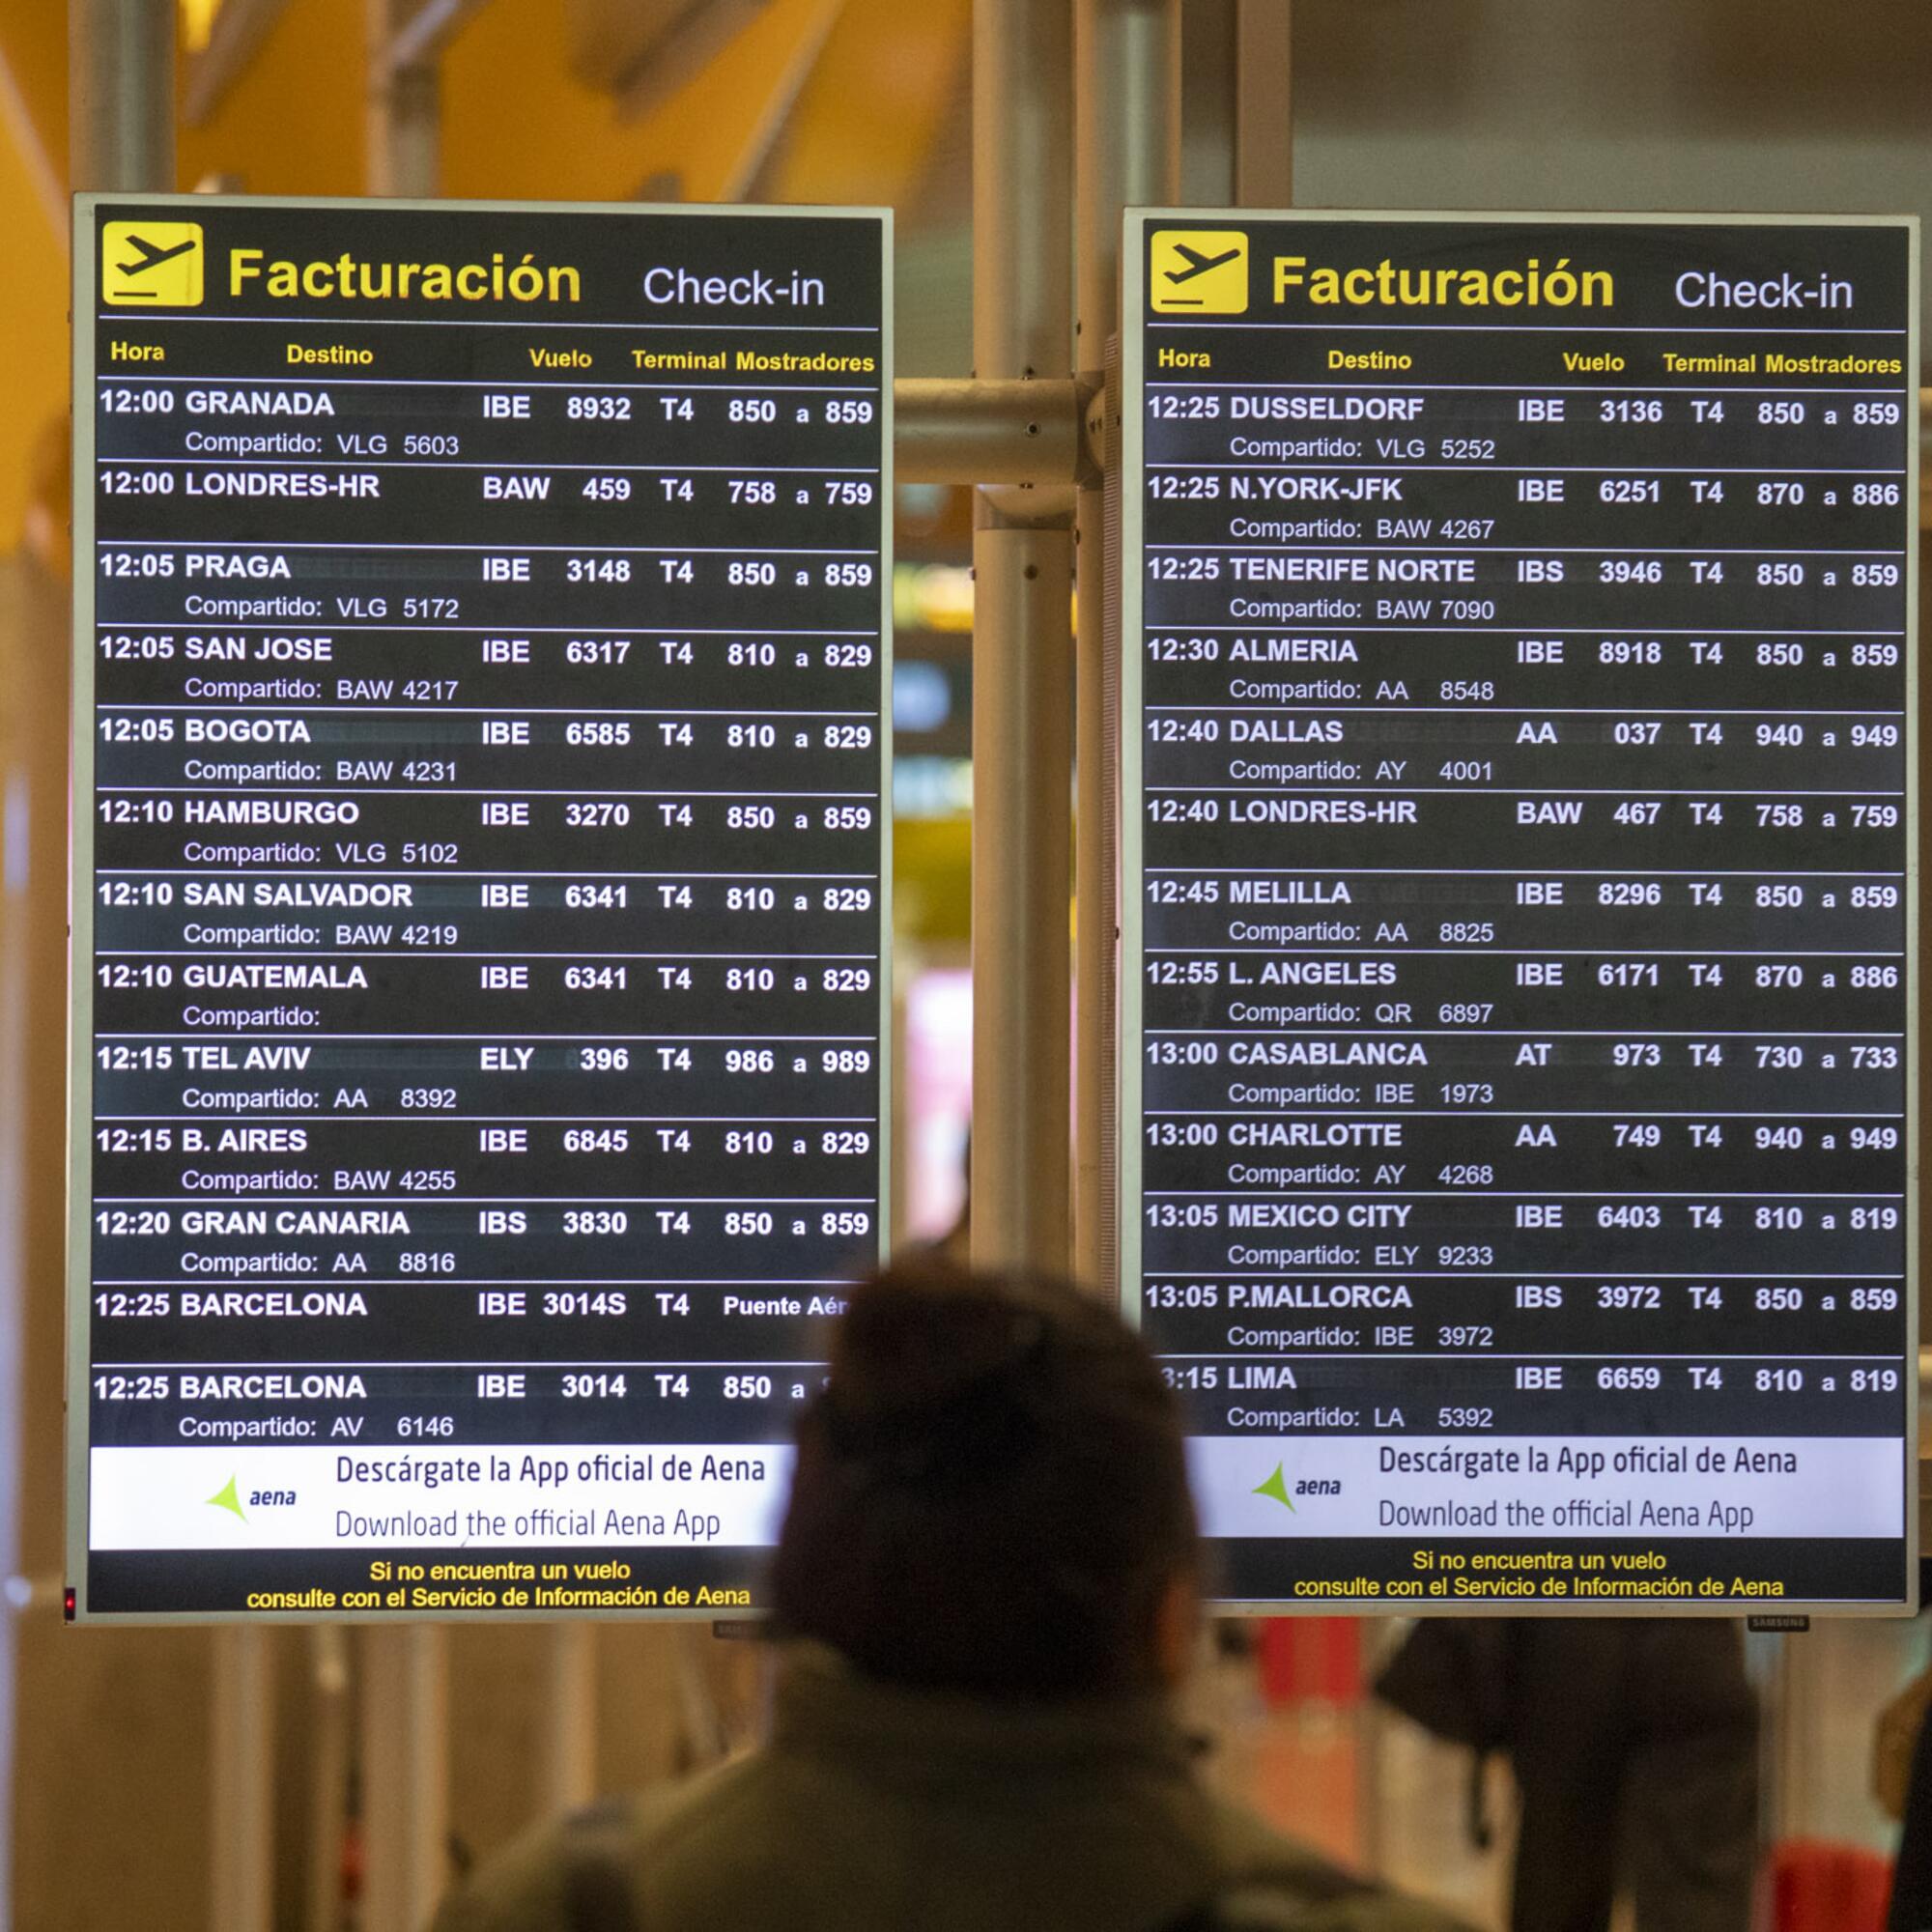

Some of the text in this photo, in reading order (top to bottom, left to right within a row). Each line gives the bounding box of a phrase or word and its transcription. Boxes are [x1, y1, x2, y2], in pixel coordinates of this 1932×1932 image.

[231, 249, 823, 305] Facturación Check-in
[1274, 257, 1852, 308] Facturación Check-in
[111, 341, 874, 372] Hora Destino Vuelo Terminal Mostradores
[1159, 349, 1901, 373] Hora Destino Vuelo Terminal Mostradores
[1148, 395, 1900, 425] 12:25 DUSSELDORF IBE 3136 T4 850 a 859
[100, 471, 872, 505] 12:00 LONDRES-HR BAW 459 T4 758 a 759
[1230, 598, 1494, 622] Compartido: BAW 7090
[99, 718, 871, 749] 12:05 BOGOTA IBE 6585 T4 810 a 829
[1148, 719, 1898, 747] 12:40 DALLAS AA 037 T4 940 a 949
[185, 759, 455, 785] Compartido: BAW 4231
[1230, 759, 1492, 784] Compartido: AY 4001
[99, 964, 870, 991] 12:10 GUATEMALA IBE 6341 T4 810 a 829
[1147, 961, 1897, 987] 12:55 L. ANGELES IBE 6171 T4 870 a 886
[1229, 1083, 1493, 1107] Compartido: IBE 1973
[182, 1170, 456, 1194] Compartido: BAW 4255
[96, 1210, 869, 1236] 12:20 GRAN CANARIA IBS 3830 T4 850 a 859
[1146, 1285, 1897, 1310] 13:05 P.MALLORCA IBS 3972 T4 850 a 859
[179, 1416, 454, 1441] Compartido: AV 6146
[338, 1455, 764, 1488] Descárgate la App oficial de Aena
[1380, 1445, 1796, 1479] Descárgate la App oficial de Aena
[250, 1492, 295, 1504] aena
[1296, 1481, 1341, 1494] aena
[337, 1510, 719, 1541] Download the official Aena App
[1380, 1500, 1753, 1533] Download the official Aena App
[370, 1560, 631, 1580] Si no encuentra un vuelo
[1413, 1551, 1665, 1569] Si no encuentra un vuelo
[247, 1586, 751, 1607] consulte con el Servicio de Información de Aena
[1294, 1577, 1783, 1595] consulte con el Servicio de Información de Aena
[1752, 1618, 1804, 1627] SAMSUNG
